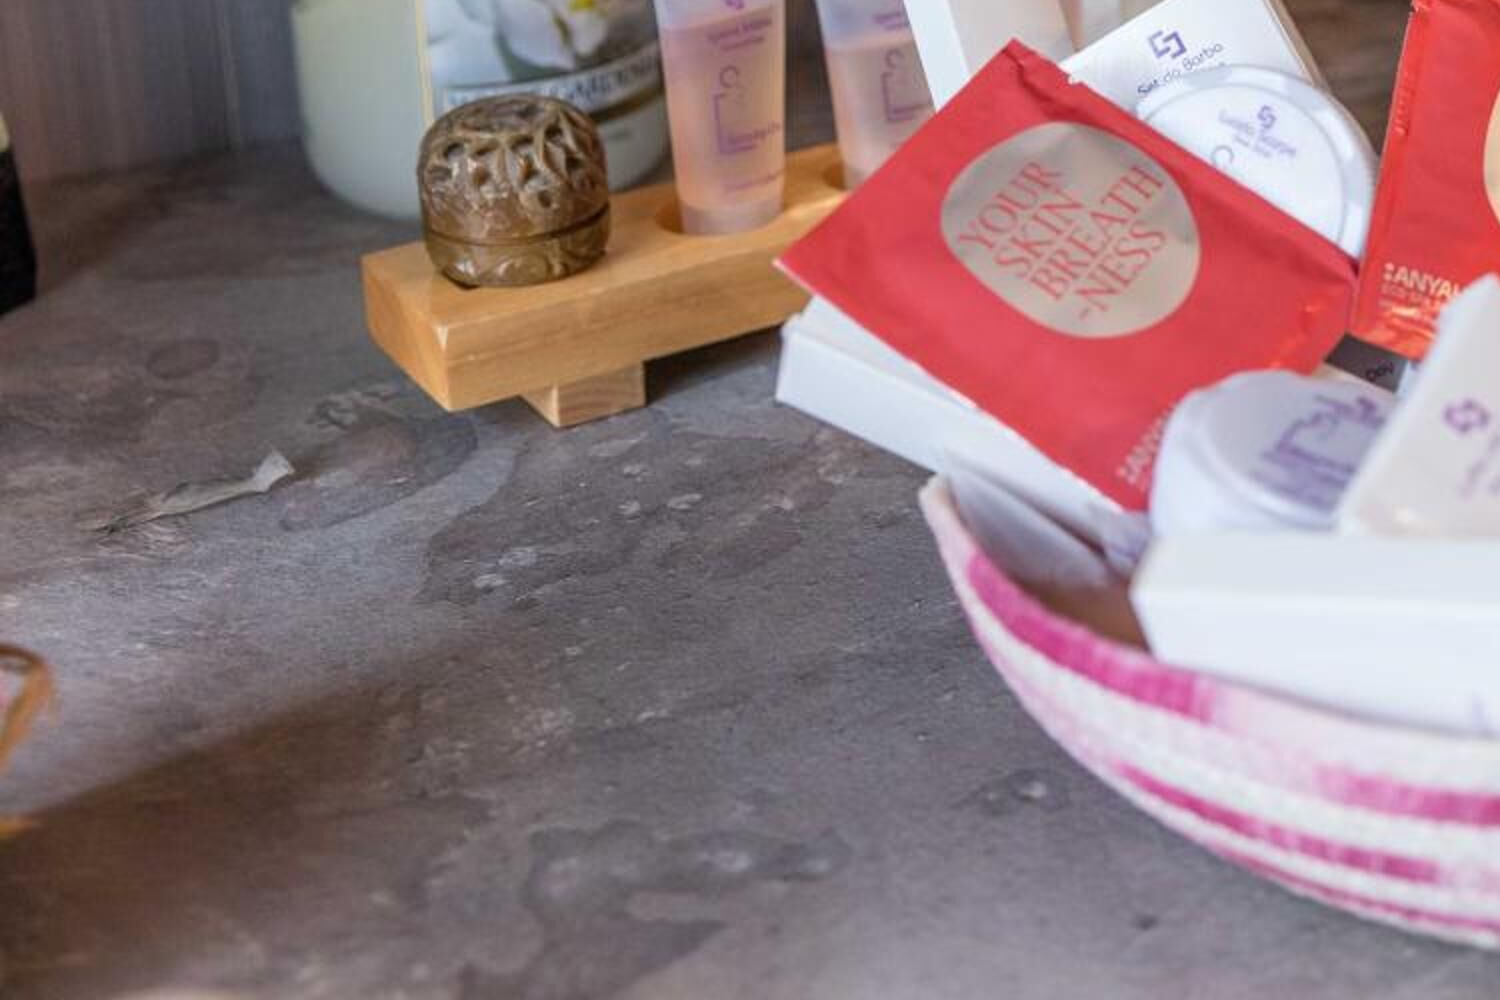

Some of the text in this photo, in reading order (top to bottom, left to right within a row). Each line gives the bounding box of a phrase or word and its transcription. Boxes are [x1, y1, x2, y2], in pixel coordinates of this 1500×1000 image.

[959, 161, 1063, 250] YOUR
[993, 184, 1083, 279] SKIN
[1029, 164, 1164, 301] BREATH
[1076, 219, 1167, 319] -NESS
